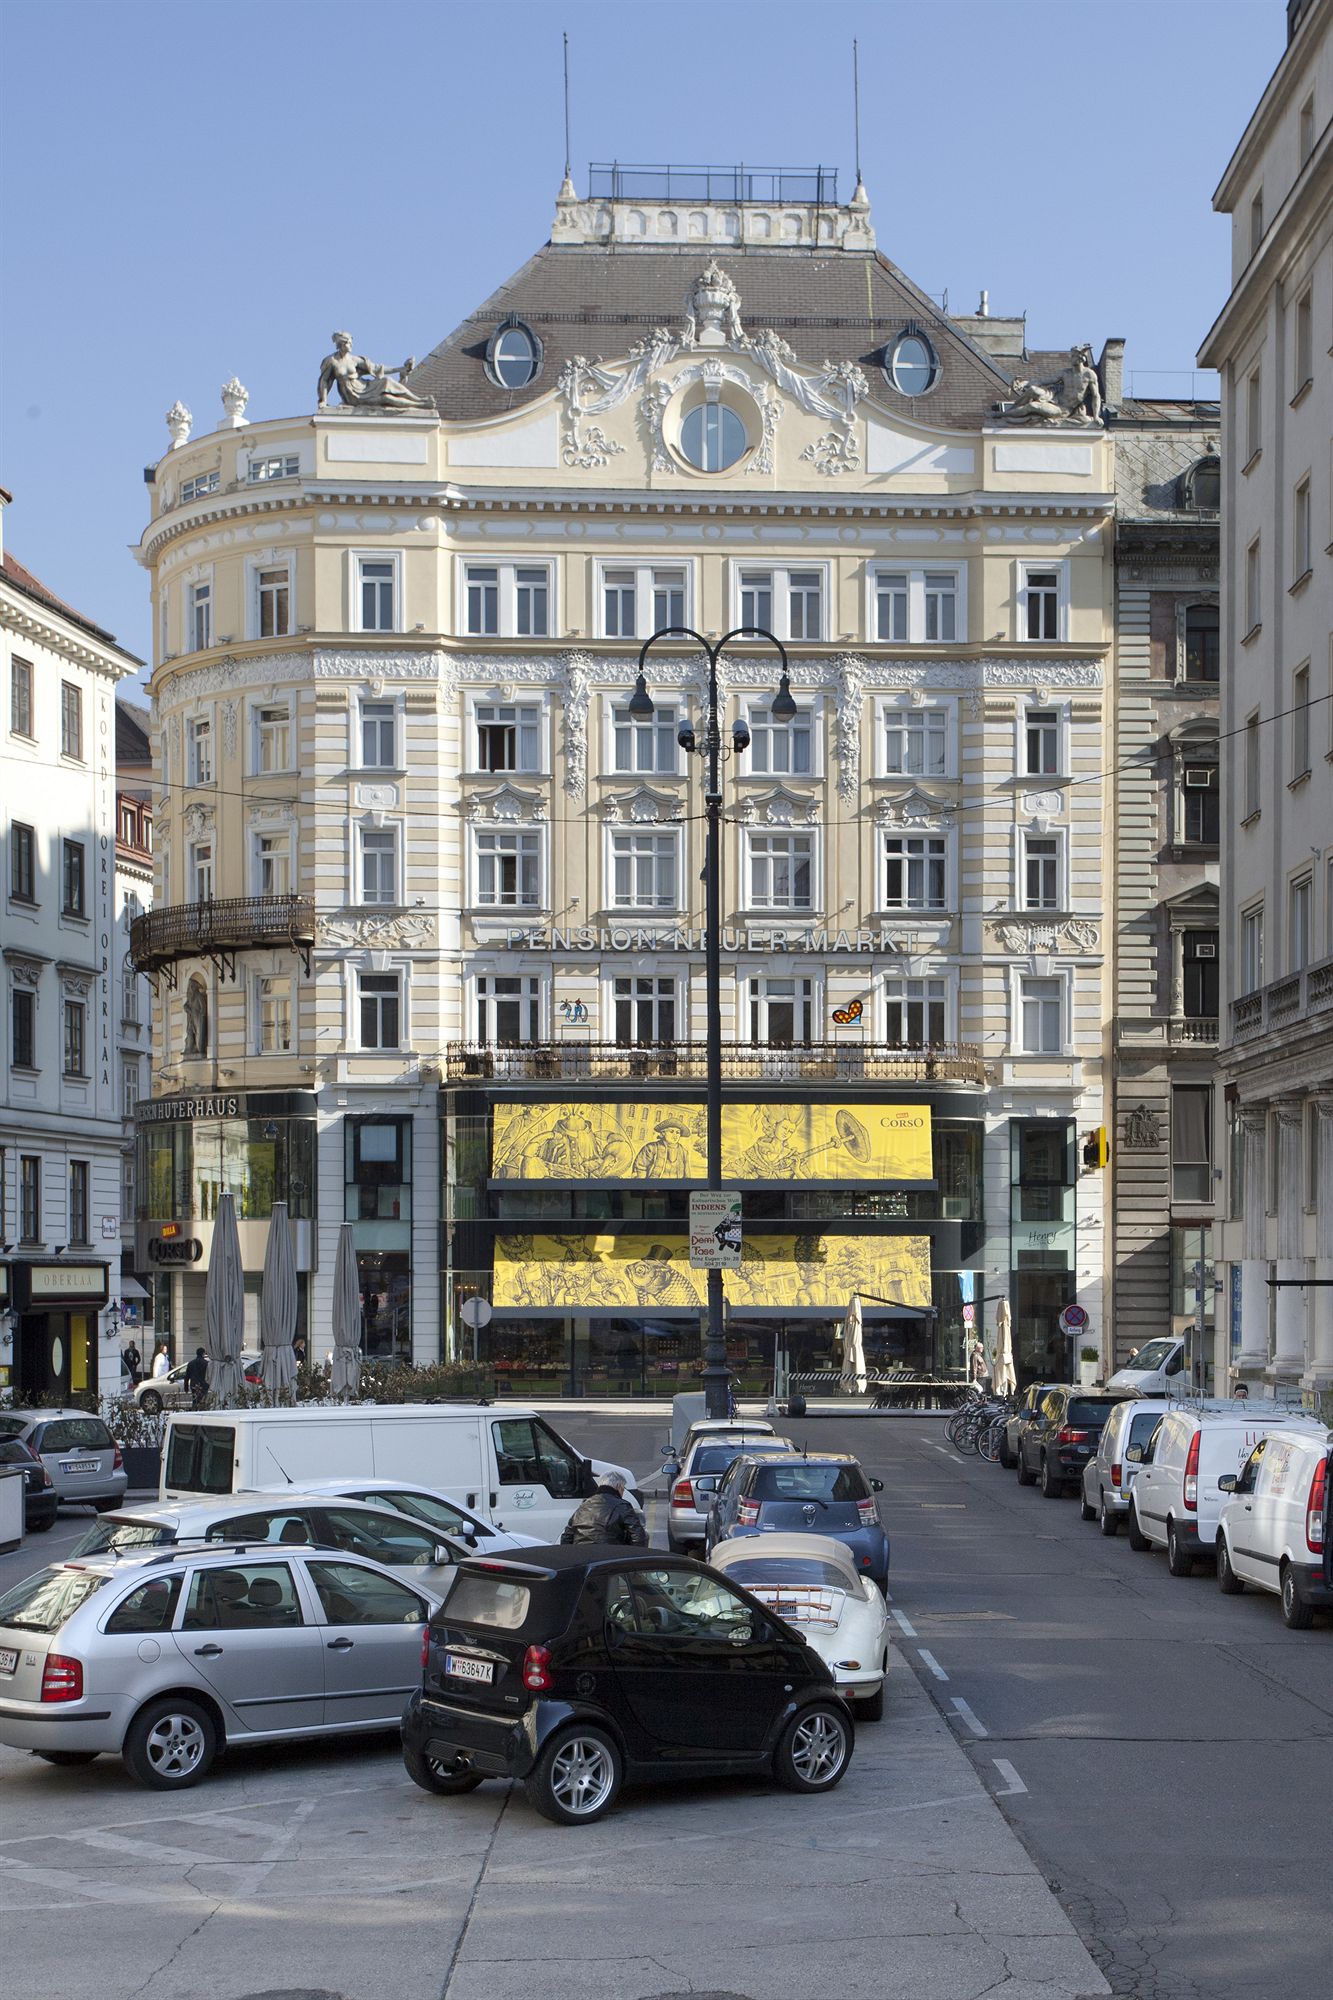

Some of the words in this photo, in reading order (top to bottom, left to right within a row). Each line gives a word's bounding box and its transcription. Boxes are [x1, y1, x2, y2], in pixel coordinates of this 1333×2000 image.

[99, 695, 109, 919] KONDITOREI
[506, 927, 657, 951] PENSION
[804, 928, 918, 953] MARKT
[101, 932, 110, 1086] OBERLAA
[691, 1235, 715, 1245] Demi
[1028, 1231, 1057, 1245] Henry
[43, 1274, 92, 1287] OBERLAA
